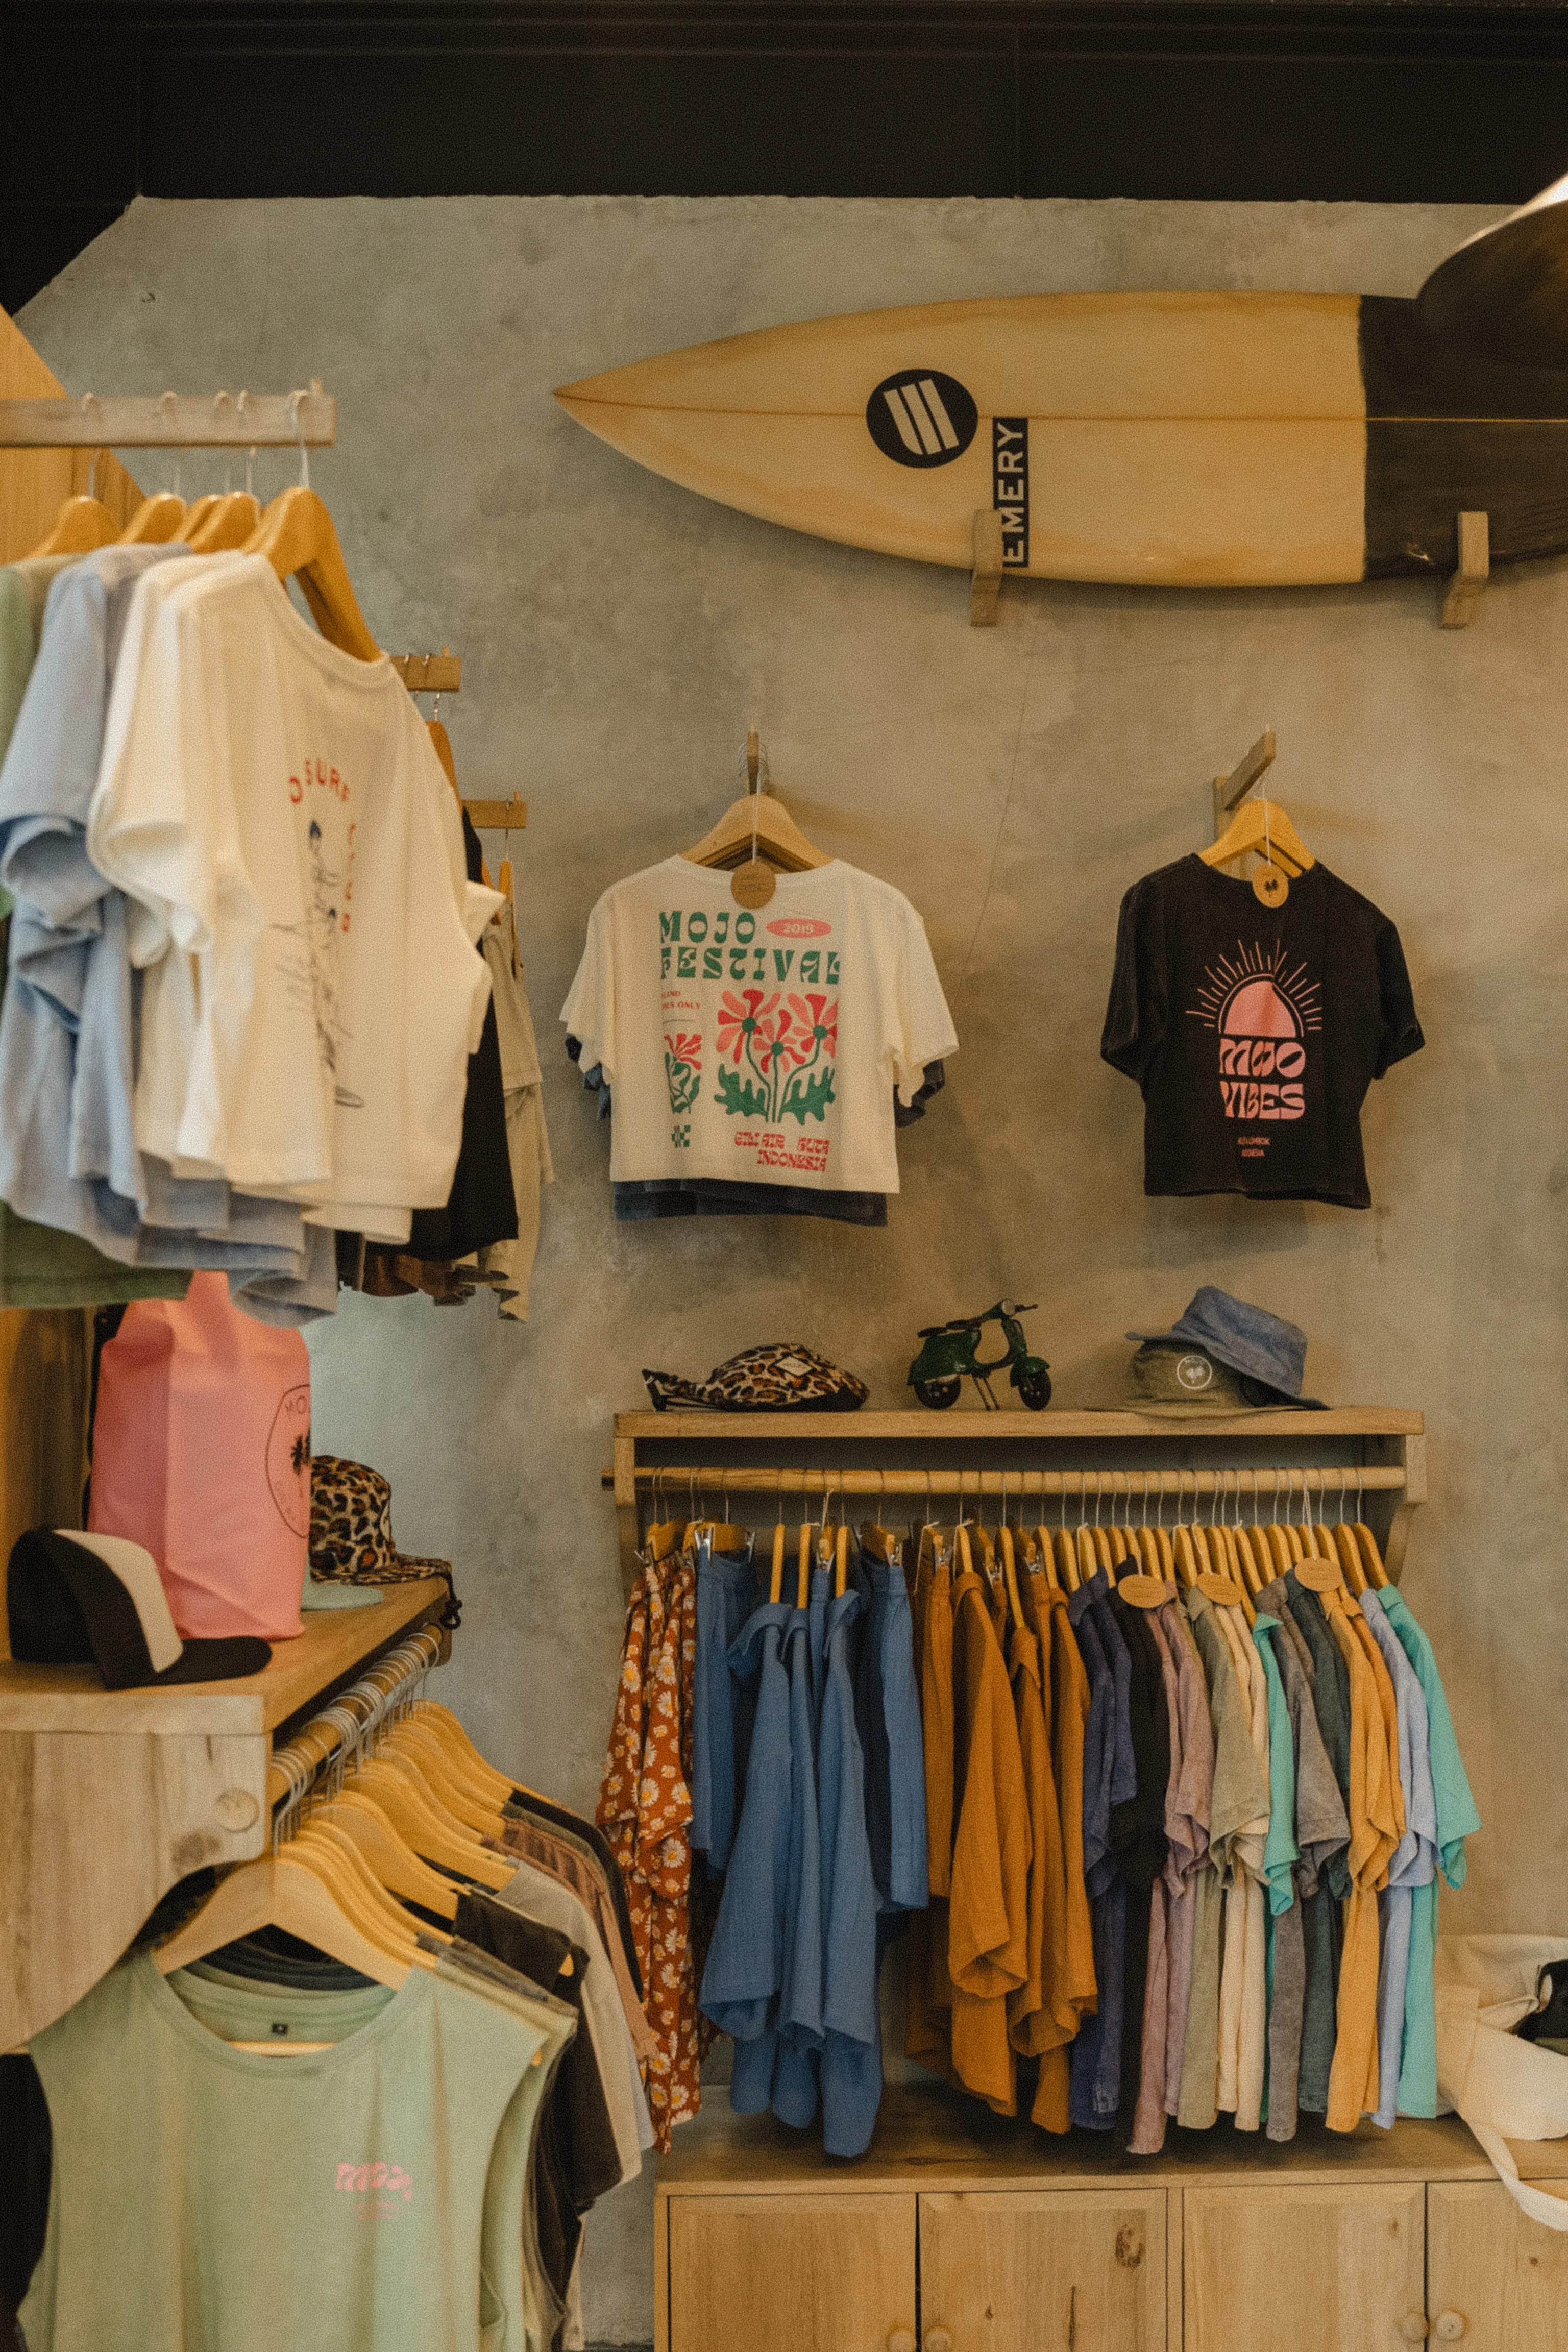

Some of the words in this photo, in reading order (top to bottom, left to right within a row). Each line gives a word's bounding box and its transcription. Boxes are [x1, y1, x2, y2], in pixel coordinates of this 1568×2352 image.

[998, 423, 1024, 562] EMERY
[659, 911, 755, 944] MOJO
[783, 923, 814, 934] 2019
[660, 946, 840, 985] FESTIVAL
[677, 1001, 701, 1010] ONLY
[1219, 1081, 1306, 1120] VIBES
[757, 1149, 827, 1172] INDONESIA
